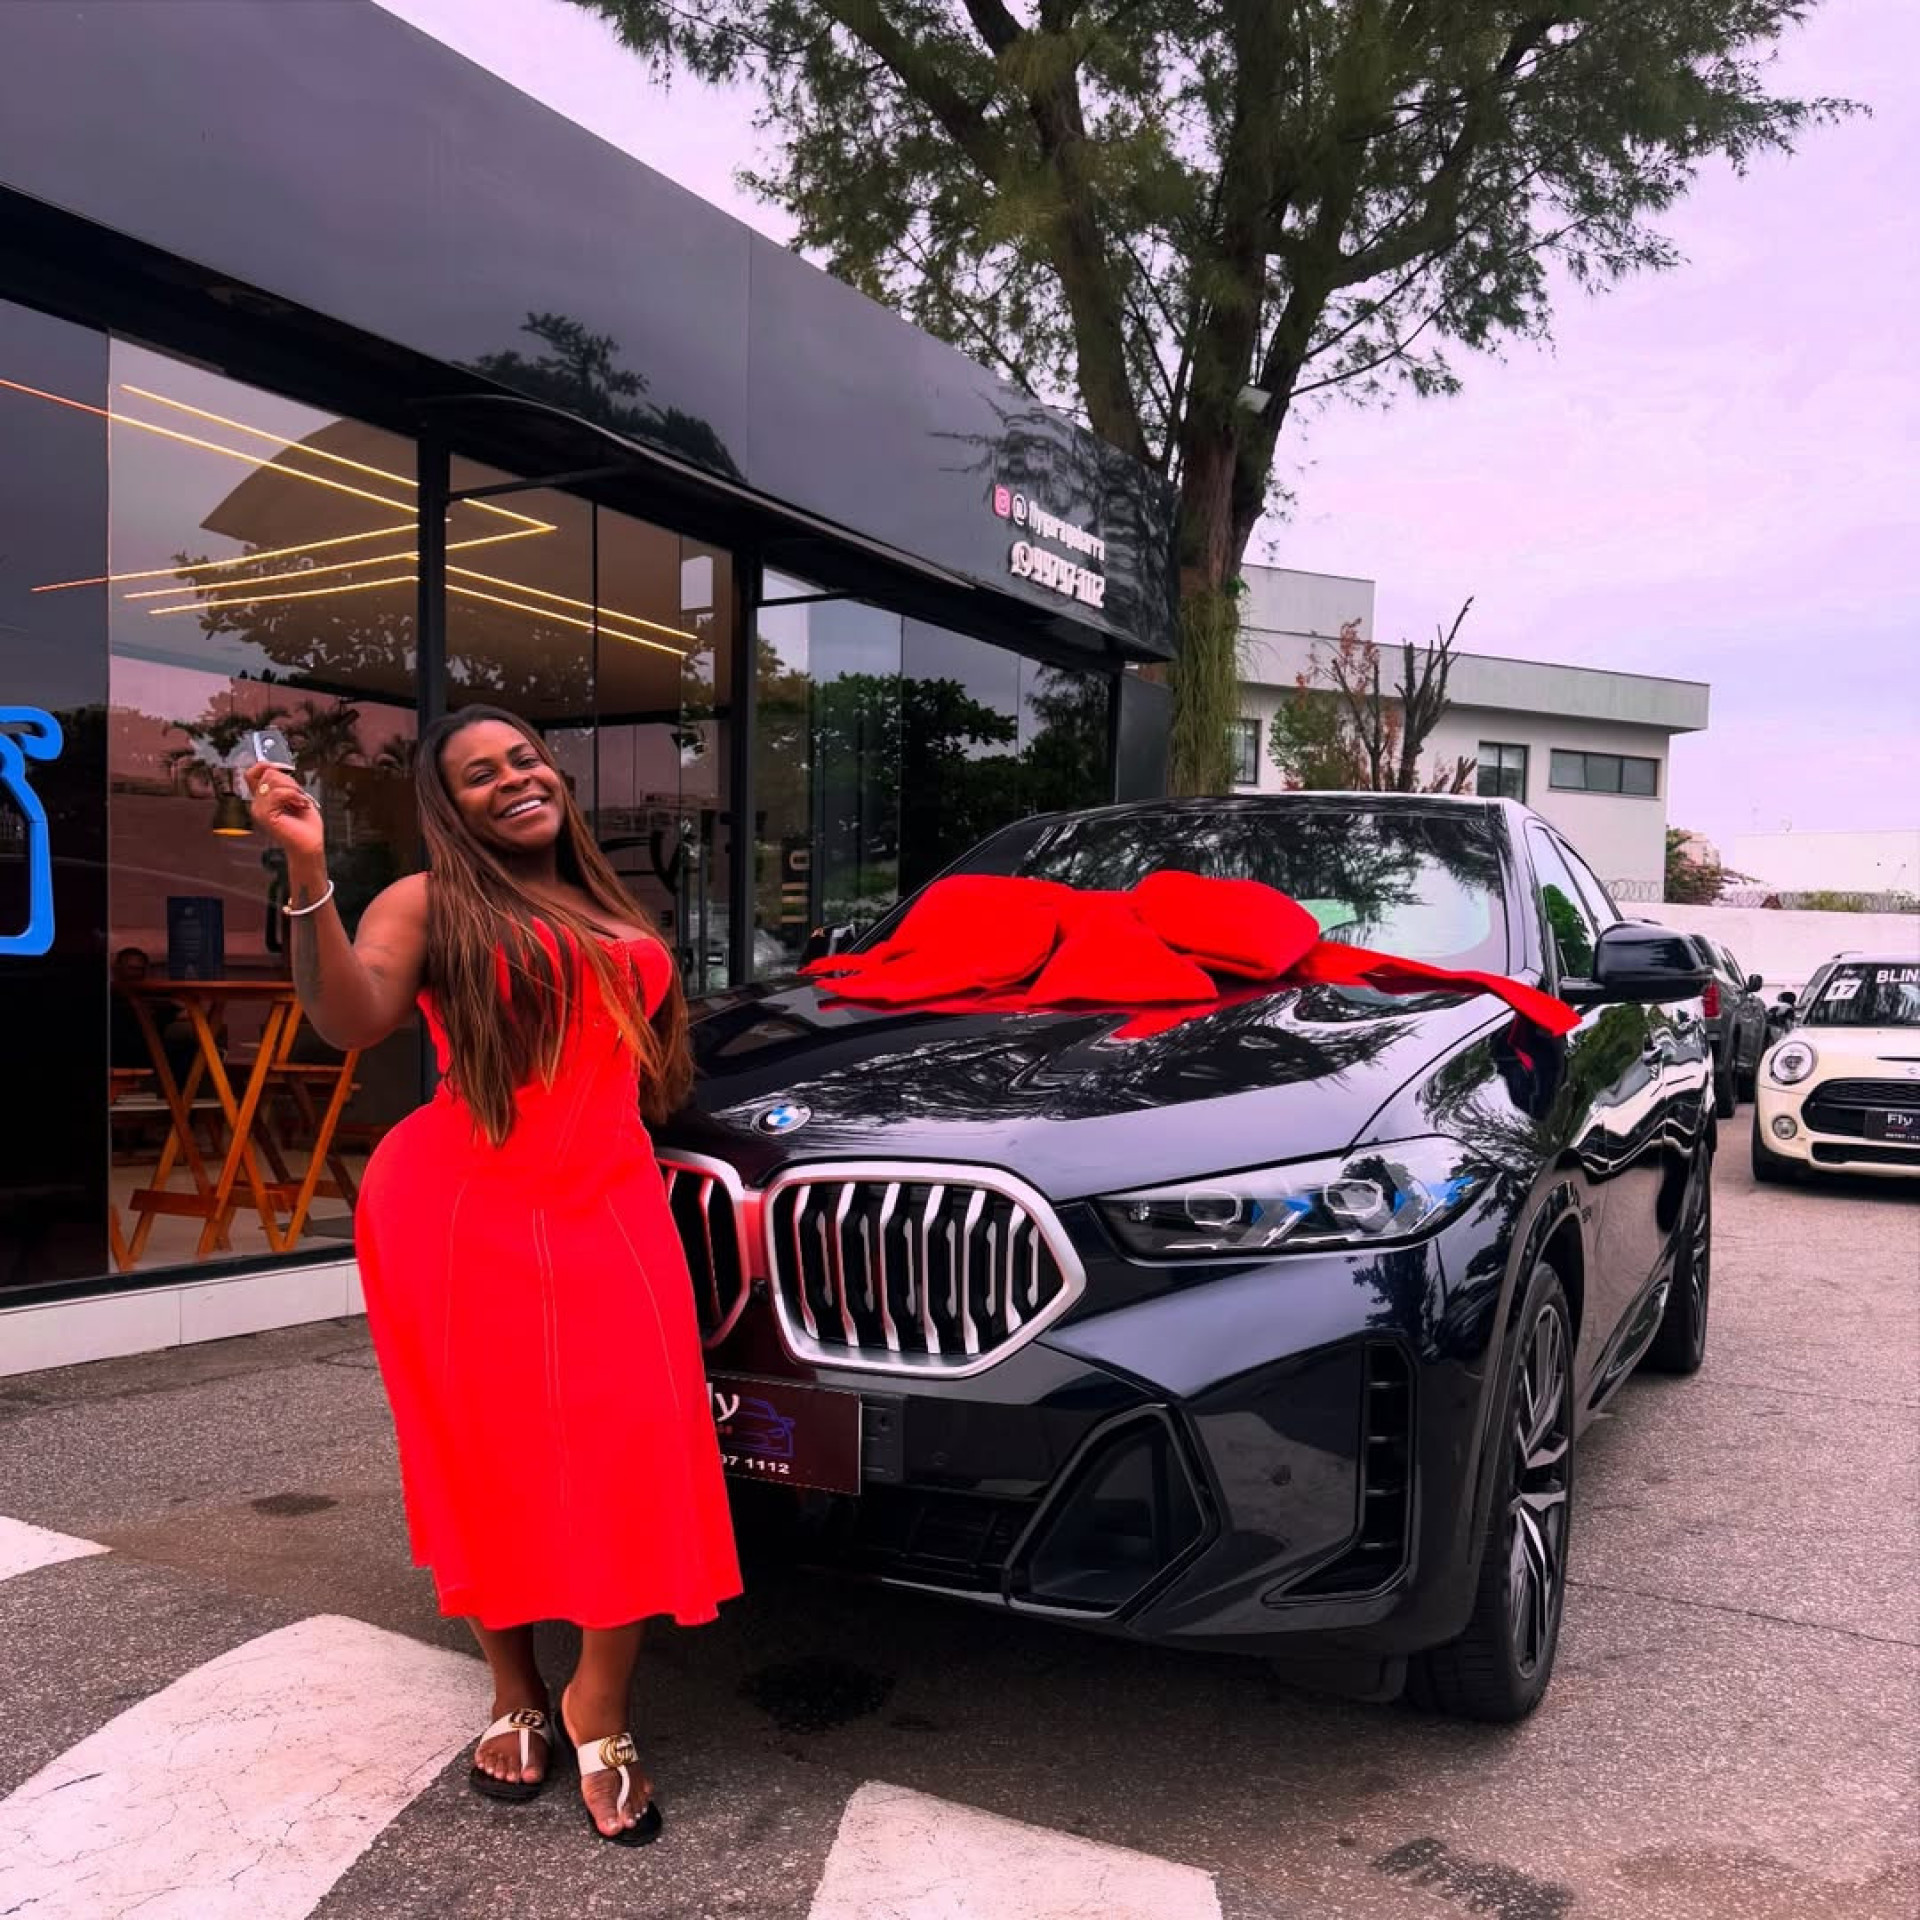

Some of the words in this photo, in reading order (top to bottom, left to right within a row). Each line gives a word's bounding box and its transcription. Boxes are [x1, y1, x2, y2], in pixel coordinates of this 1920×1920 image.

[1831, 983, 1857, 998] 17
[1886, 1112, 1914, 1127] Fly
[744, 1457, 790, 1475] 1112
